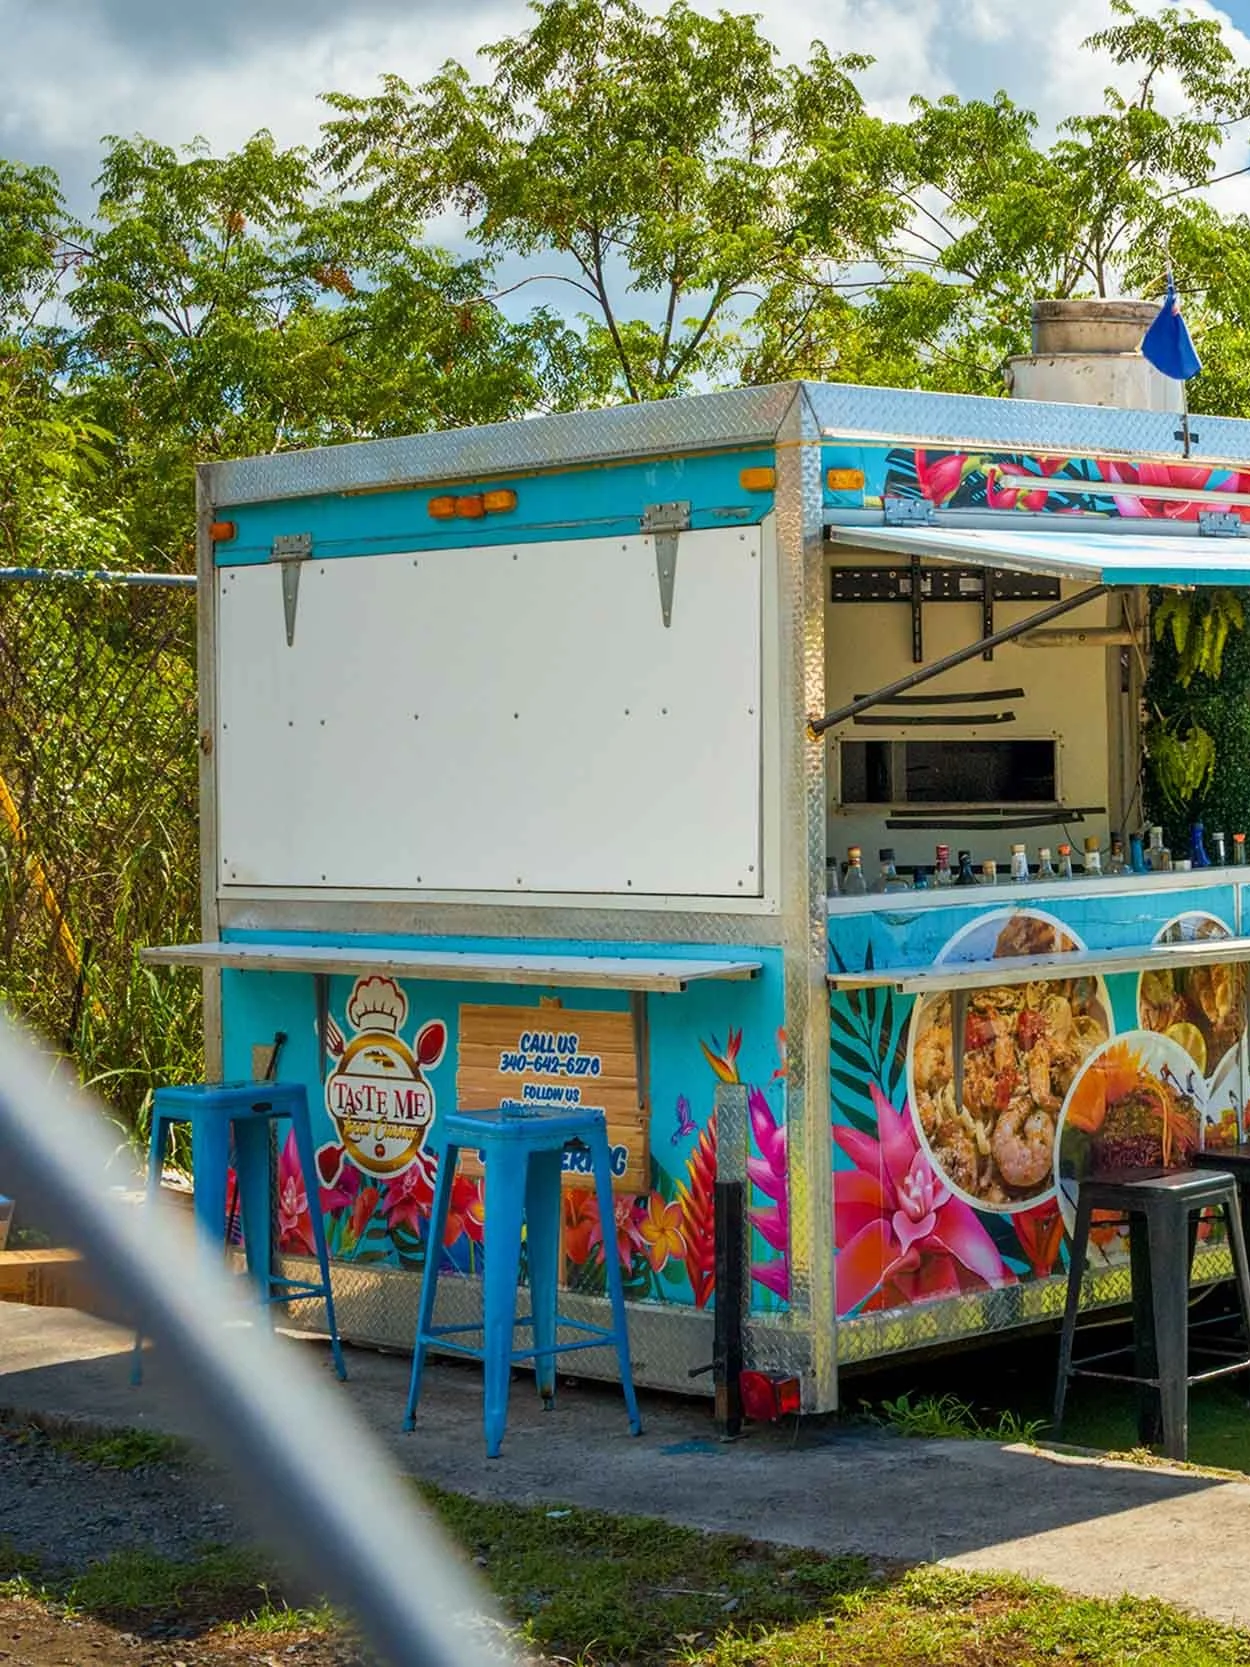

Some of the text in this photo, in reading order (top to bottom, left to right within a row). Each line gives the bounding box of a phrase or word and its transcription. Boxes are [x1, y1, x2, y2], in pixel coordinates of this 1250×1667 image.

[520, 1033, 578, 1054] CALL US
[334, 1082, 425, 1120] TASTE ME
[523, 1085, 580, 1102] FOLLOW US
